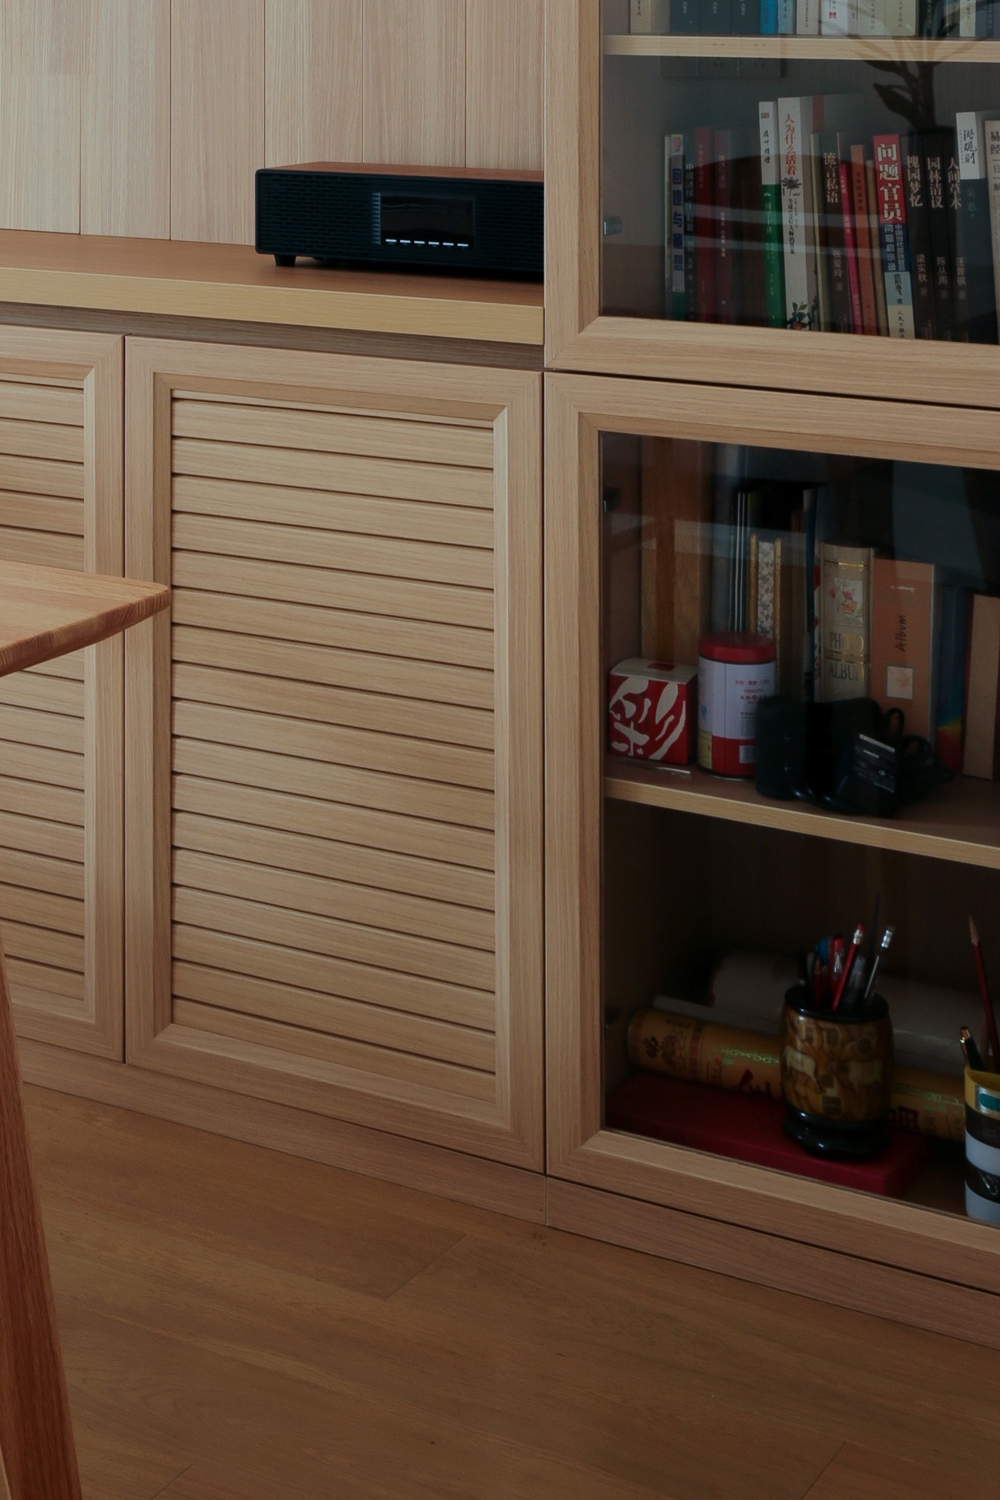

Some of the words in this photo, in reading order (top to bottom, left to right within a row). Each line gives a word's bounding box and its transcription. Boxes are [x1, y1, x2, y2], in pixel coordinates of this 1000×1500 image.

[784, 113, 797, 177] 人为什么活着
[823, 151, 839, 204] 流言私语
[876, 142, 904, 222] 问题官员
[906, 154, 923, 208] 槐园梦忆
[926, 156, 944, 209] 园林清议
[947, 156, 962, 210] 人间草木
[831, 248, 843, 278] 张爱玲
[884, 224, 897, 273] 问题启示录
[916, 253, 928, 283] 梁实秋
[936, 256, 948, 286] 陈从周
[829, 632, 865, 652] PHOTO
[893, 614, 908, 653] Album
